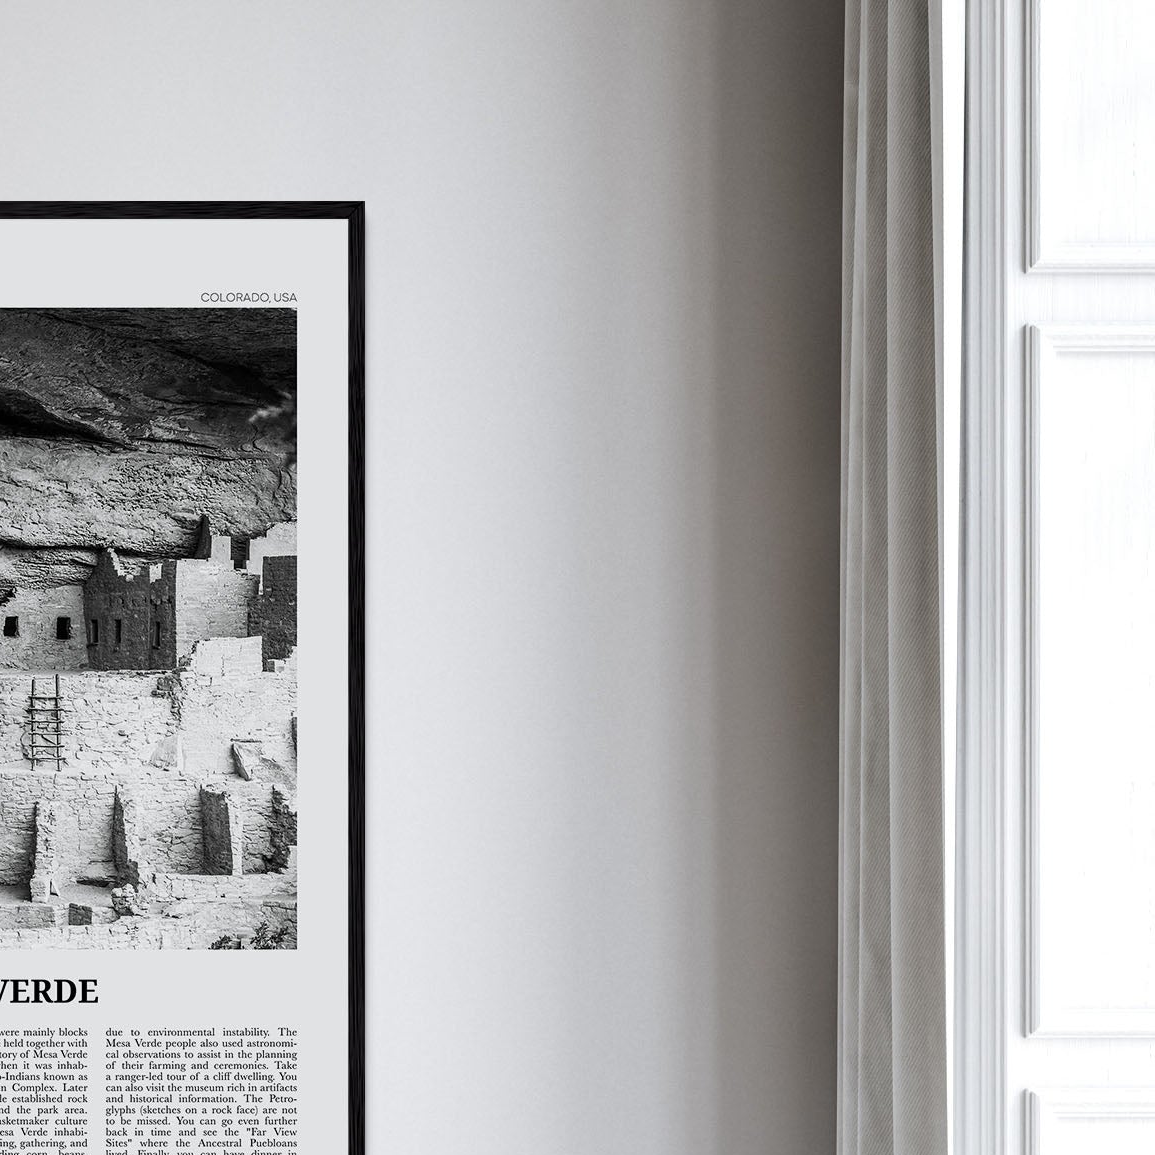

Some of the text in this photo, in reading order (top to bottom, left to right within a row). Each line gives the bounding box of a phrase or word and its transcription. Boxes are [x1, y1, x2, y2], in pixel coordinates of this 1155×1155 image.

[201, 292, 298, 303] COLORADO, USA
[23, 1028, 56, 1039] mainly
[59, 1028, 88, 1037] blocks
[105, 1028, 298, 1039] due to environmental instability. The
[19, 1050, 31, 1059] of
[33, 1050, 58, 1059] Mesa
[60, 1050, 88, 1059] Verde
[105, 1050, 298, 1061] cal observations to assist in the planning
[44, 1072, 75, 1081] known
[115, 1072, 163, 1083] ranger-led
[166, 1072, 187, 1081] tour
[189, 1072, 201, 1081] of
[213, 1072, 232, 1081] cliff
[233, 1072, 275, 1083] dwelling.
[279, 1072, 297, 1081] You
[12, 1094, 63, 1103] established
[68, 1094, 88, 1103] rock
[105, 1094, 297, 1103] and historical information. The Petro-
[55, 1116, 88, 1125] culture
[106, 1116, 116, 1125] to
[120, 1116, 132, 1125] be
[137, 1116, 171, 1125] missed.
[176, 1116, 195, 1125] You
[221, 1118, 233, 1128] go
[265, 1116, 298, 1125] further
[19, 1139, 67, 1150] gathering,
[70, 1139, 88, 1148] and
[105, 1139, 298, 1148] Sites" where the Ancestral Puebloans
